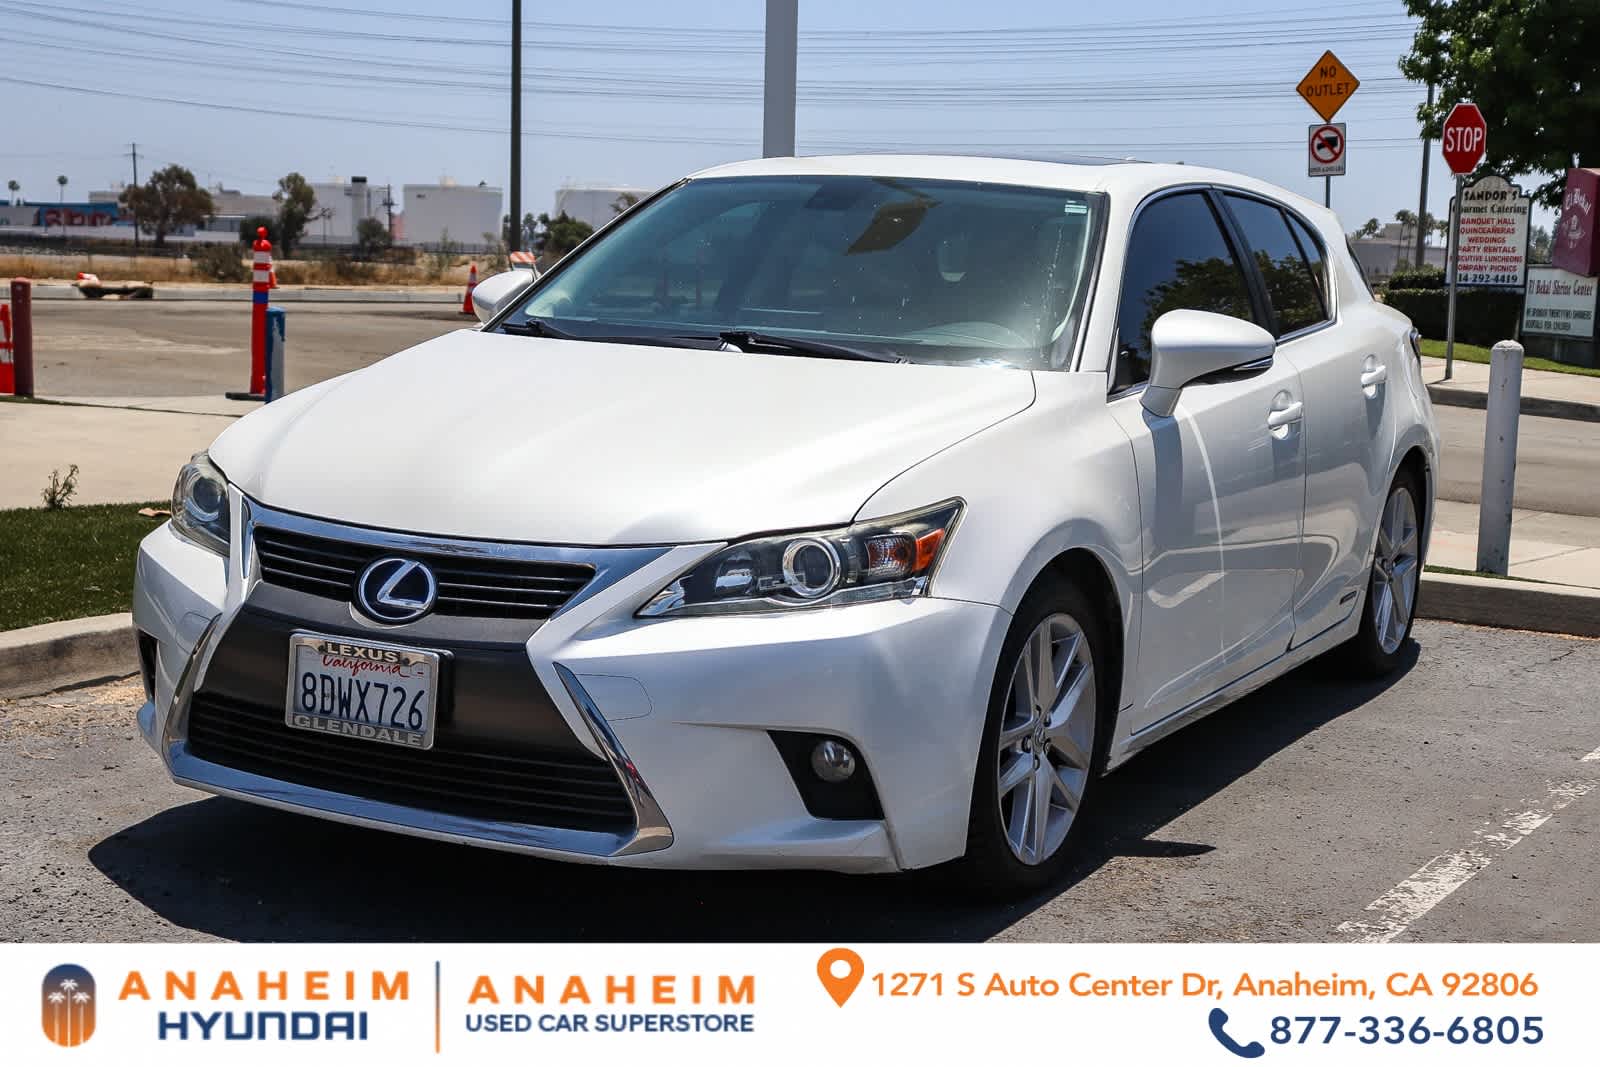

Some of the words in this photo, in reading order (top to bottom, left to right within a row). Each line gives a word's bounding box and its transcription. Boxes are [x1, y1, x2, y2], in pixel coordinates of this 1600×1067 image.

[1320, 65, 1337, 78] NO
[1306, 82, 1352, 97] OUTLET
[1446, 126, 1483, 152] STOP
[1464, 190, 1518, 201] SANDOR'S
[1490, 203, 1528, 215] Catering
[1461, 217, 1495, 225] BANQUET
[1498, 217, 1515, 225] HALL
[1467, 236, 1506, 244] WEDDINGS
[1456, 264, 1488, 272] OMPANY
[1490, 265, 1517, 273] PICNICS
[1457, 273, 1518, 284] 14-292-4419
[327, 642, 399, 663] LEXUS
[322, 655, 411, 678] California
[302, 672, 425, 731] 8DWX726
[294, 715, 423, 746] GLENDALE
